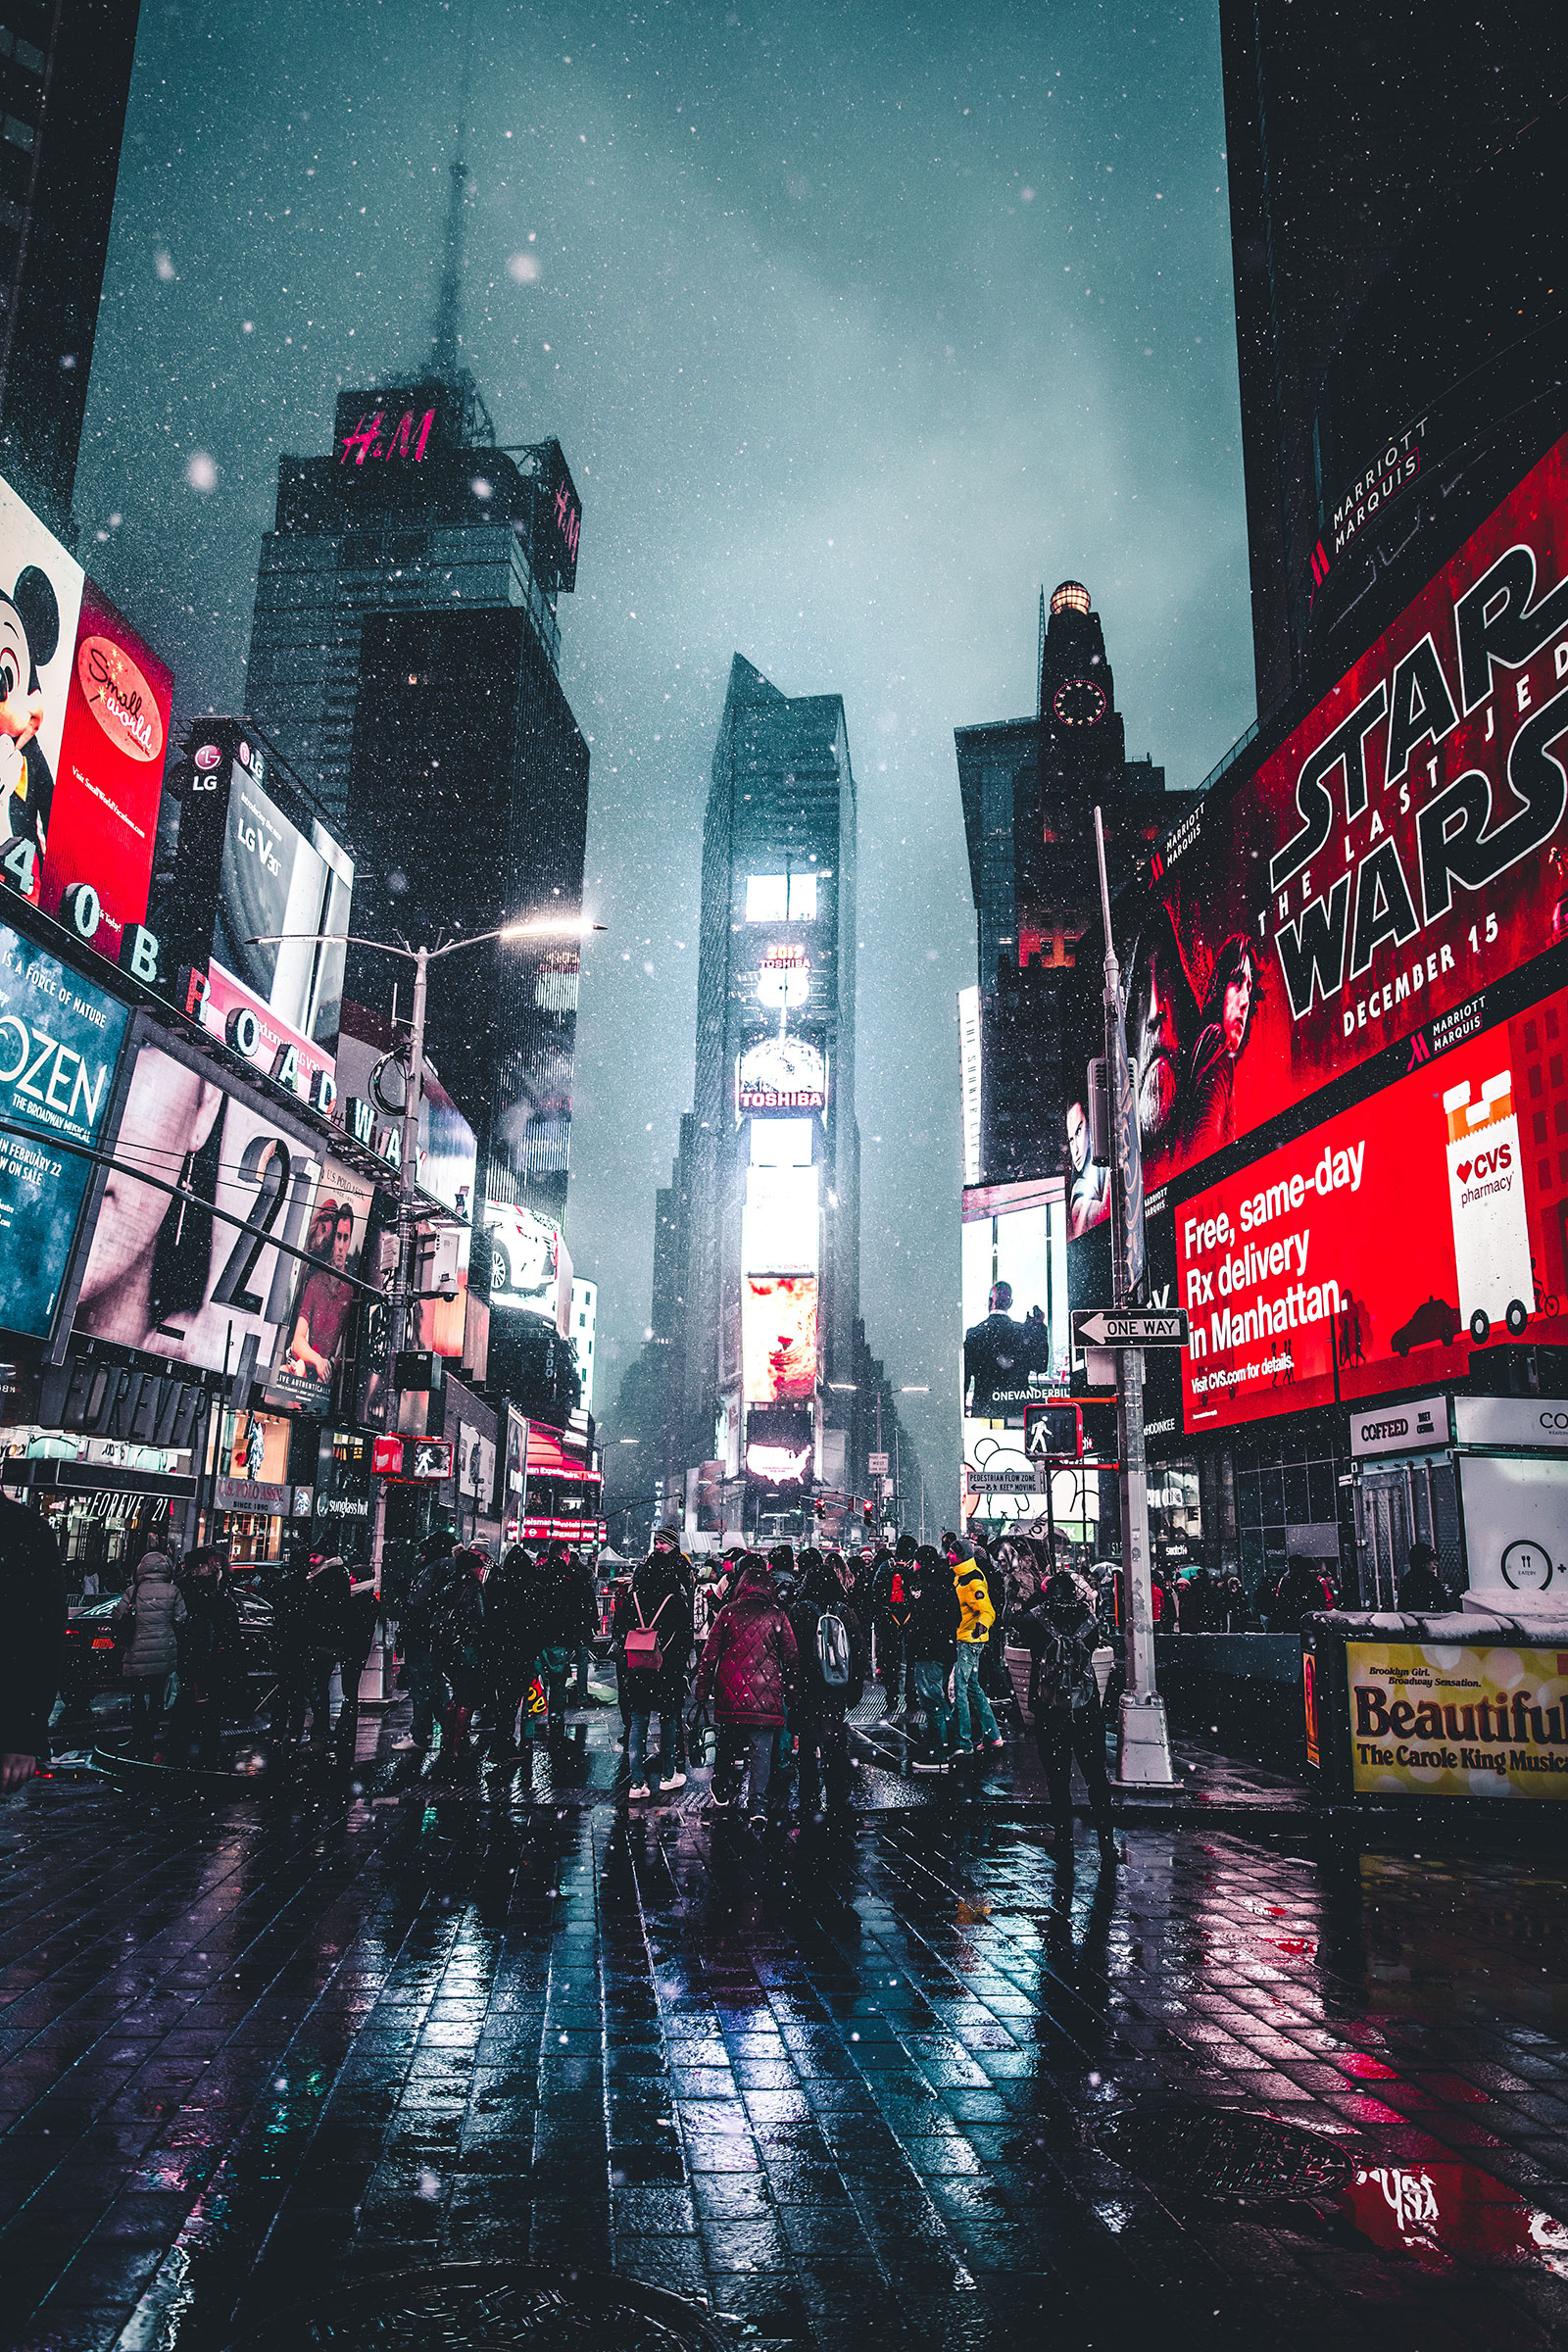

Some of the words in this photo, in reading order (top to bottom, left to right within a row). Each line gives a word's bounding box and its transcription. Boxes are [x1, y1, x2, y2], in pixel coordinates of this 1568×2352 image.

[341, 408, 436, 466] H&M
[1333, 417, 1428, 530] MARRIOTT
[1336, 455, 1417, 555] MARQUIS
[89, 649, 142, 720] Small
[1270, 544, 1568, 894] STAR
[193, 775, 218, 791] LG
[249, 754, 264, 779] LG
[238, 817, 256, 853] LG
[1166, 802, 1204, 853] MARRIOTT
[1167, 823, 1201, 867] MARQUIS
[1258, 870, 1311, 936] THE
[1344, 756, 1438, 862] LAST
[1274, 687, 1568, 1021] WARS
[760, 958, 811, 969] TOSHIBA
[1344, 944, 1455, 1037] DECEMBER
[1468, 912, 1498, 954] 15
[15, 960, 23, 975] A
[25, 964, 57, 997] FORCE
[59, 988, 72, 1004] OF
[73, 997, 106, 1029] NATURE
[1433, 996, 1486, 1036] MARRIOTT
[1434, 1015, 1481, 1052] MARQUIS
[13, 1093, 26, 1110] THE
[26, 1104, 65, 1129] BROADWAY
[741, 1093, 823, 1107] TOSHIBA
[8, 1160, 23, 1176] ON
[21, 1167, 43, 1186] SALE
[9, 1143, 51, 1172] FEBRUARY
[50, 1161, 62, 1177] 22
[1474, 1143, 1512, 1178] CVS
[1184, 1216, 1235, 1259] Free,
[1240, 1141, 1366, 1233] same-day
[1461, 1174, 1513, 1207] pharmacy
[1186, 1268, 1214, 1309] Rx
[1218, 1229, 1310, 1300] delivery
[1106, 1321, 1138, 1336] ONE
[1144, 1320, 1175, 1335] WAY
[1188, 1323, 1207, 1360] in
[1212, 1279, 1348, 1352] Manhattan.
[1191, 1376, 1208, 1395] Visit
[1208, 1368, 1247, 1390] CVS.com
[1246, 1362, 1260, 1379] for
[1260, 1351, 1295, 1376] details.
[992, 1388, 1070, 1401] ONEVANDERBIL
[1361, 1418, 1408, 1442] COFFEED
[218, 1477, 235, 1497] U.S.
[235, 1480, 259, 1499] POLO
[260, 1486, 284, 1502] ASSN.
[232, 1500, 252, 1510] SINCE
[328, 1498, 358, 1518] sunglass
[357, 1495, 368, 1516] hut
[151, 1497, 169, 1521] 21
[1369, 1667, 1409, 1678] Brooklyn
[1411, 1667, 1430, 1677] Girl.
[1389, 1677, 1433, 1688] Broadway
[1434, 1678, 1482, 1688] Sensation.
[1356, 1743, 1395, 1766] The
[1396, 1745, 1457, 1769] Carole
[1460, 1747, 1506, 1775] King
